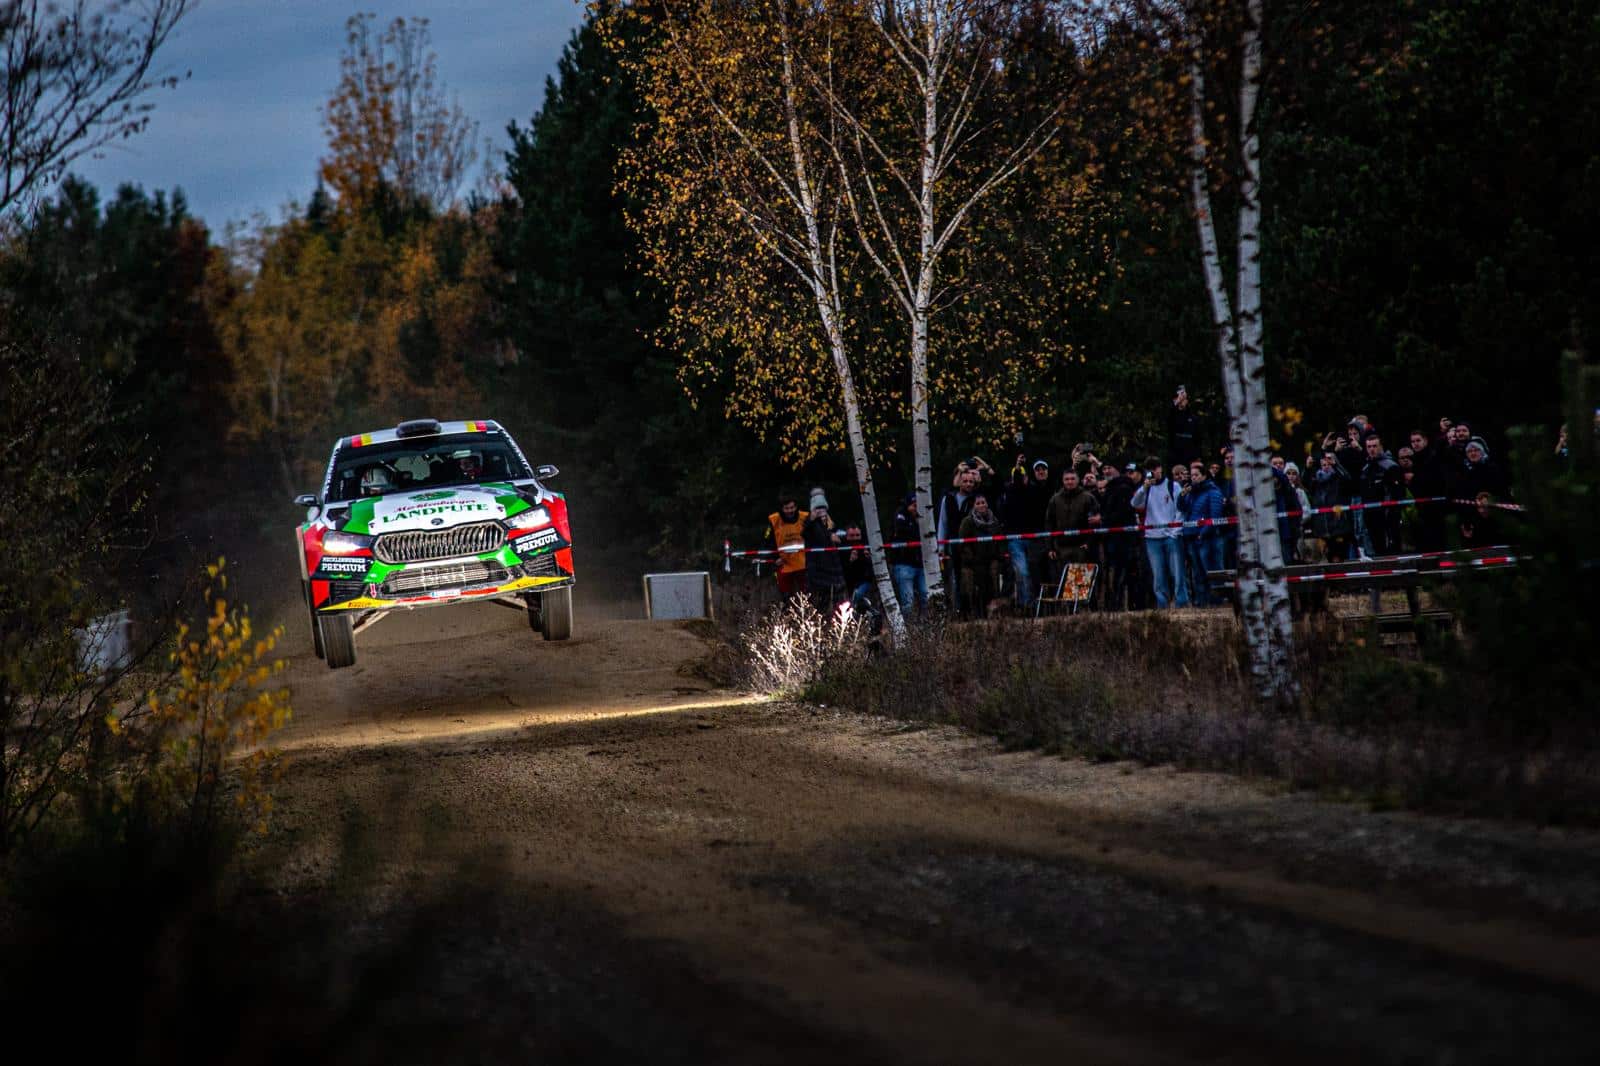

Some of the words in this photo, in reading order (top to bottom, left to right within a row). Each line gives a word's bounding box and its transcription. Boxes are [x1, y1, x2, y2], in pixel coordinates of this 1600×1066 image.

[383, 504, 488, 523] LANDPUTE
[516, 533, 559, 554] PREMIUM
[321, 563, 367, 573] PREMIUM
